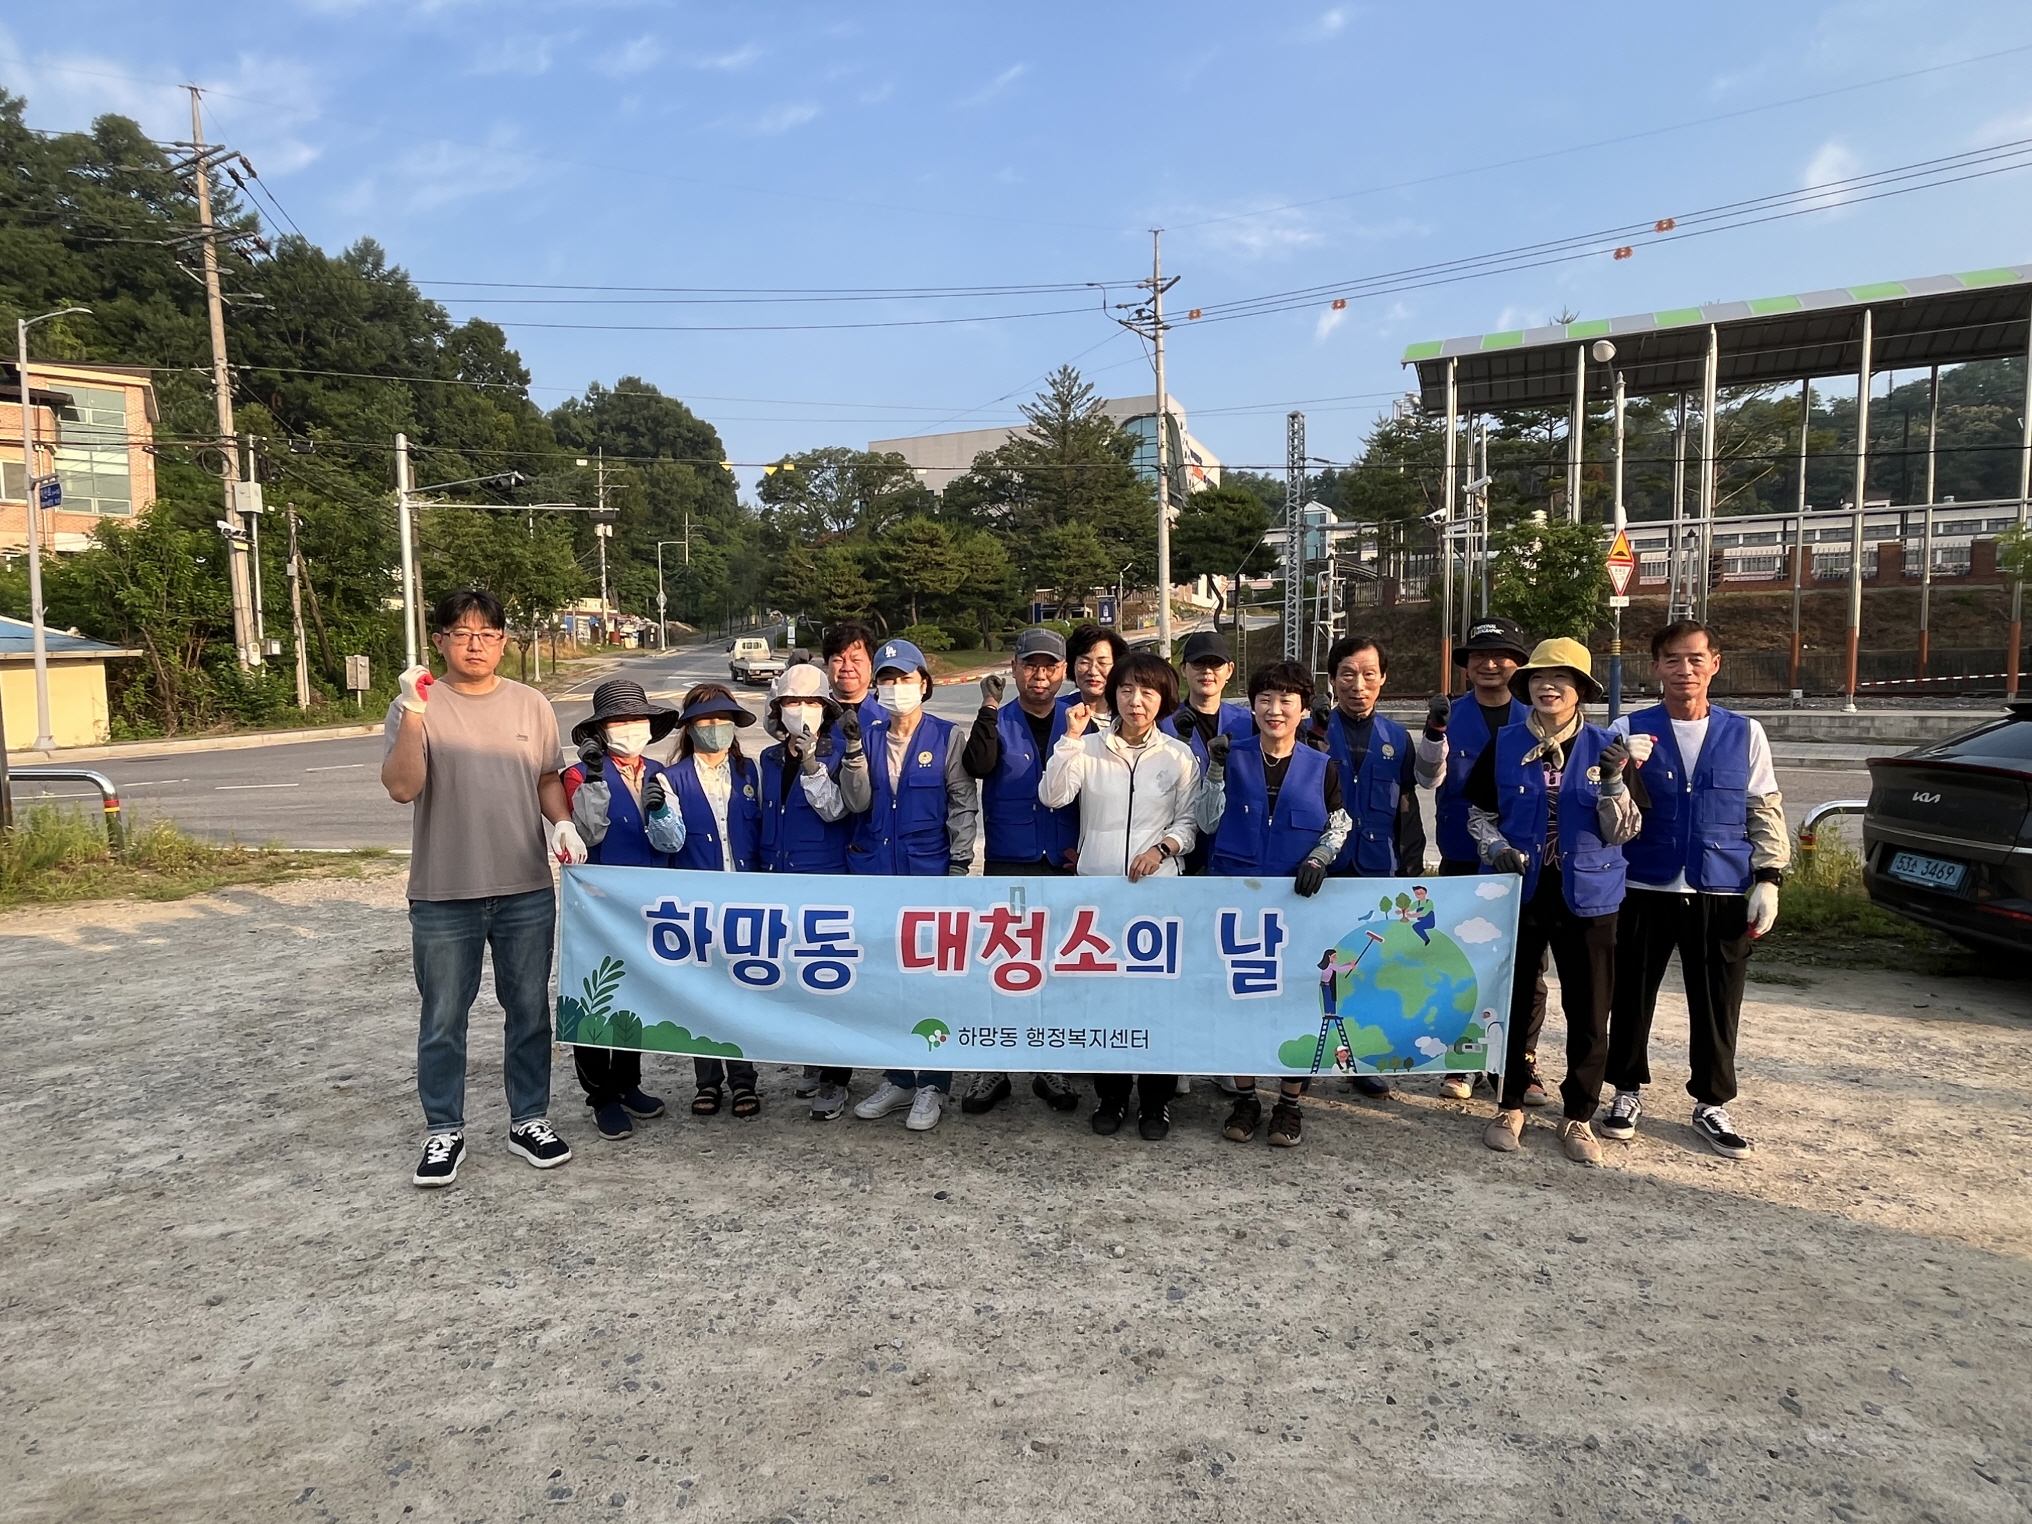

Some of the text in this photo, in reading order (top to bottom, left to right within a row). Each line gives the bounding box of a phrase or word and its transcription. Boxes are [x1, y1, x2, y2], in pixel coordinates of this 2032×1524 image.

[1920, 860, 1955, 881] 3469
[644, 899, 1285, 996] 하망동 대청소의 날
[957, 1026, 1149, 1050] 하망동 행정복지센터
